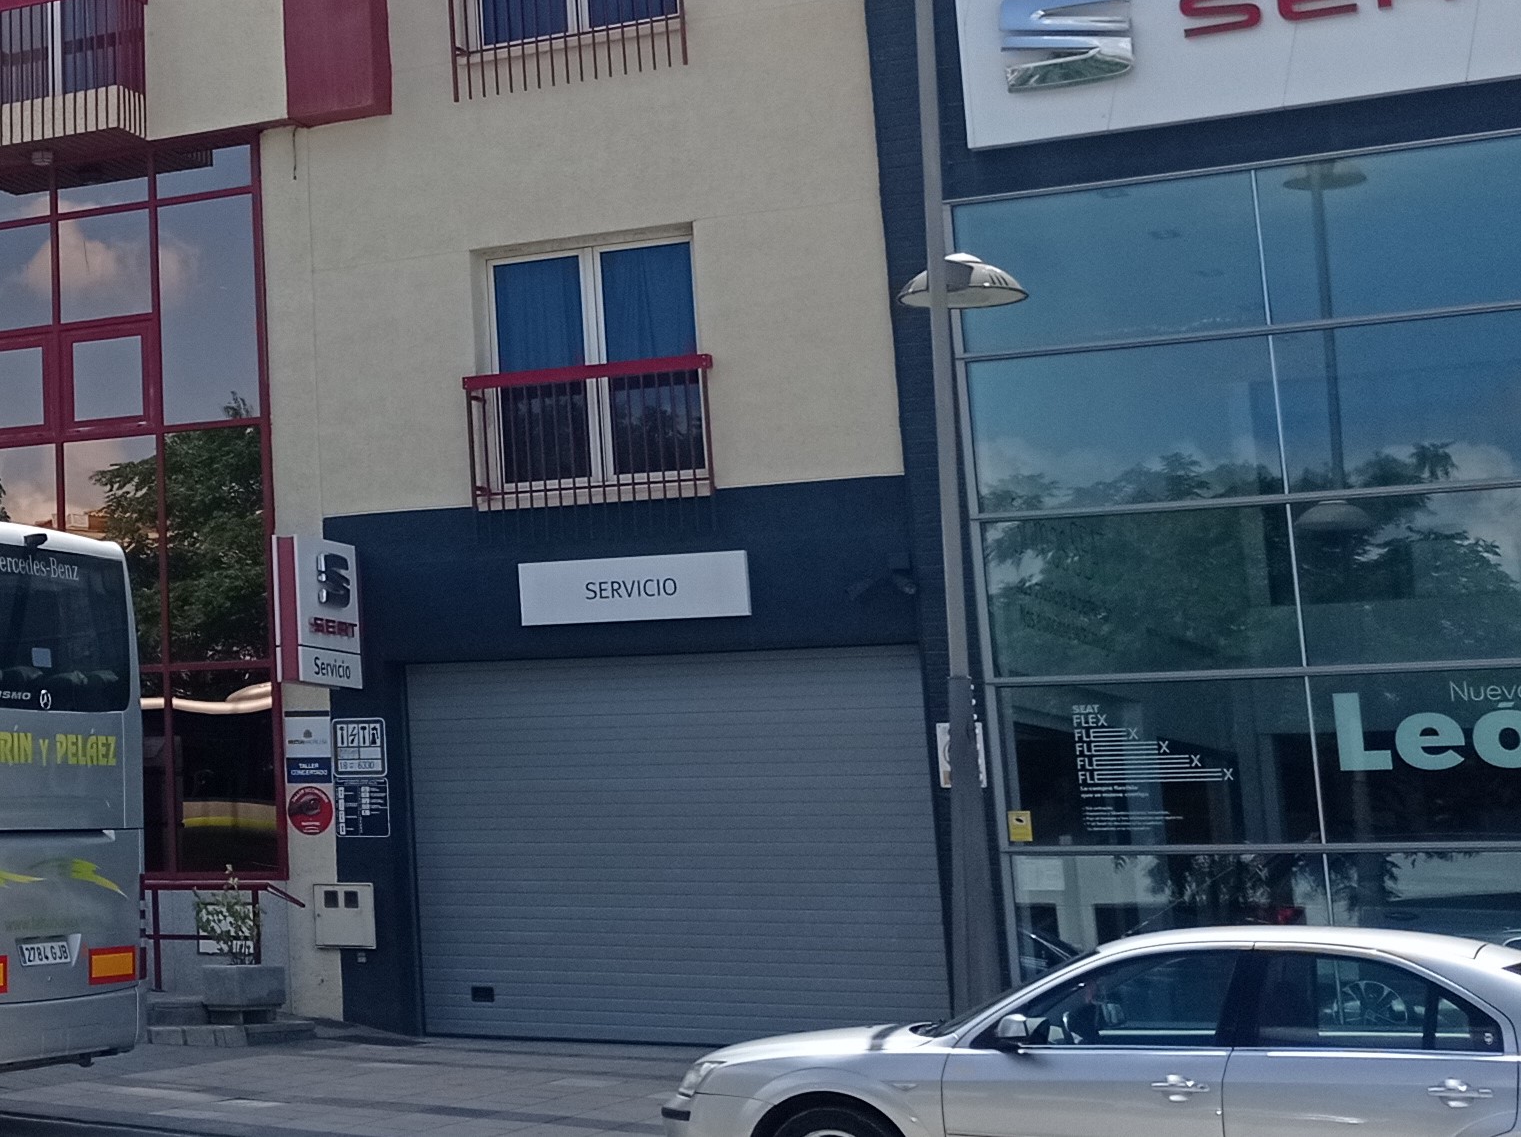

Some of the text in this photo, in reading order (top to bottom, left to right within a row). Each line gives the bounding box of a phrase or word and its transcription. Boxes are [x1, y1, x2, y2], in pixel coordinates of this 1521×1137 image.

[585, 577, 677, 600] SERVICIO
[309, 616, 358, 638] SEAT
[313, 656, 351, 680] Servicio
[1448, 680, 1521, 702] Nuev
[1072, 704, 1100, 713] SEAT
[1072, 714, 1108, 727] FLEX
[1332, 692, 1521, 771] Leó
[55, 728, 117, 768] PELÁEZ
[25, 944, 69, 963] 2784 GJB
